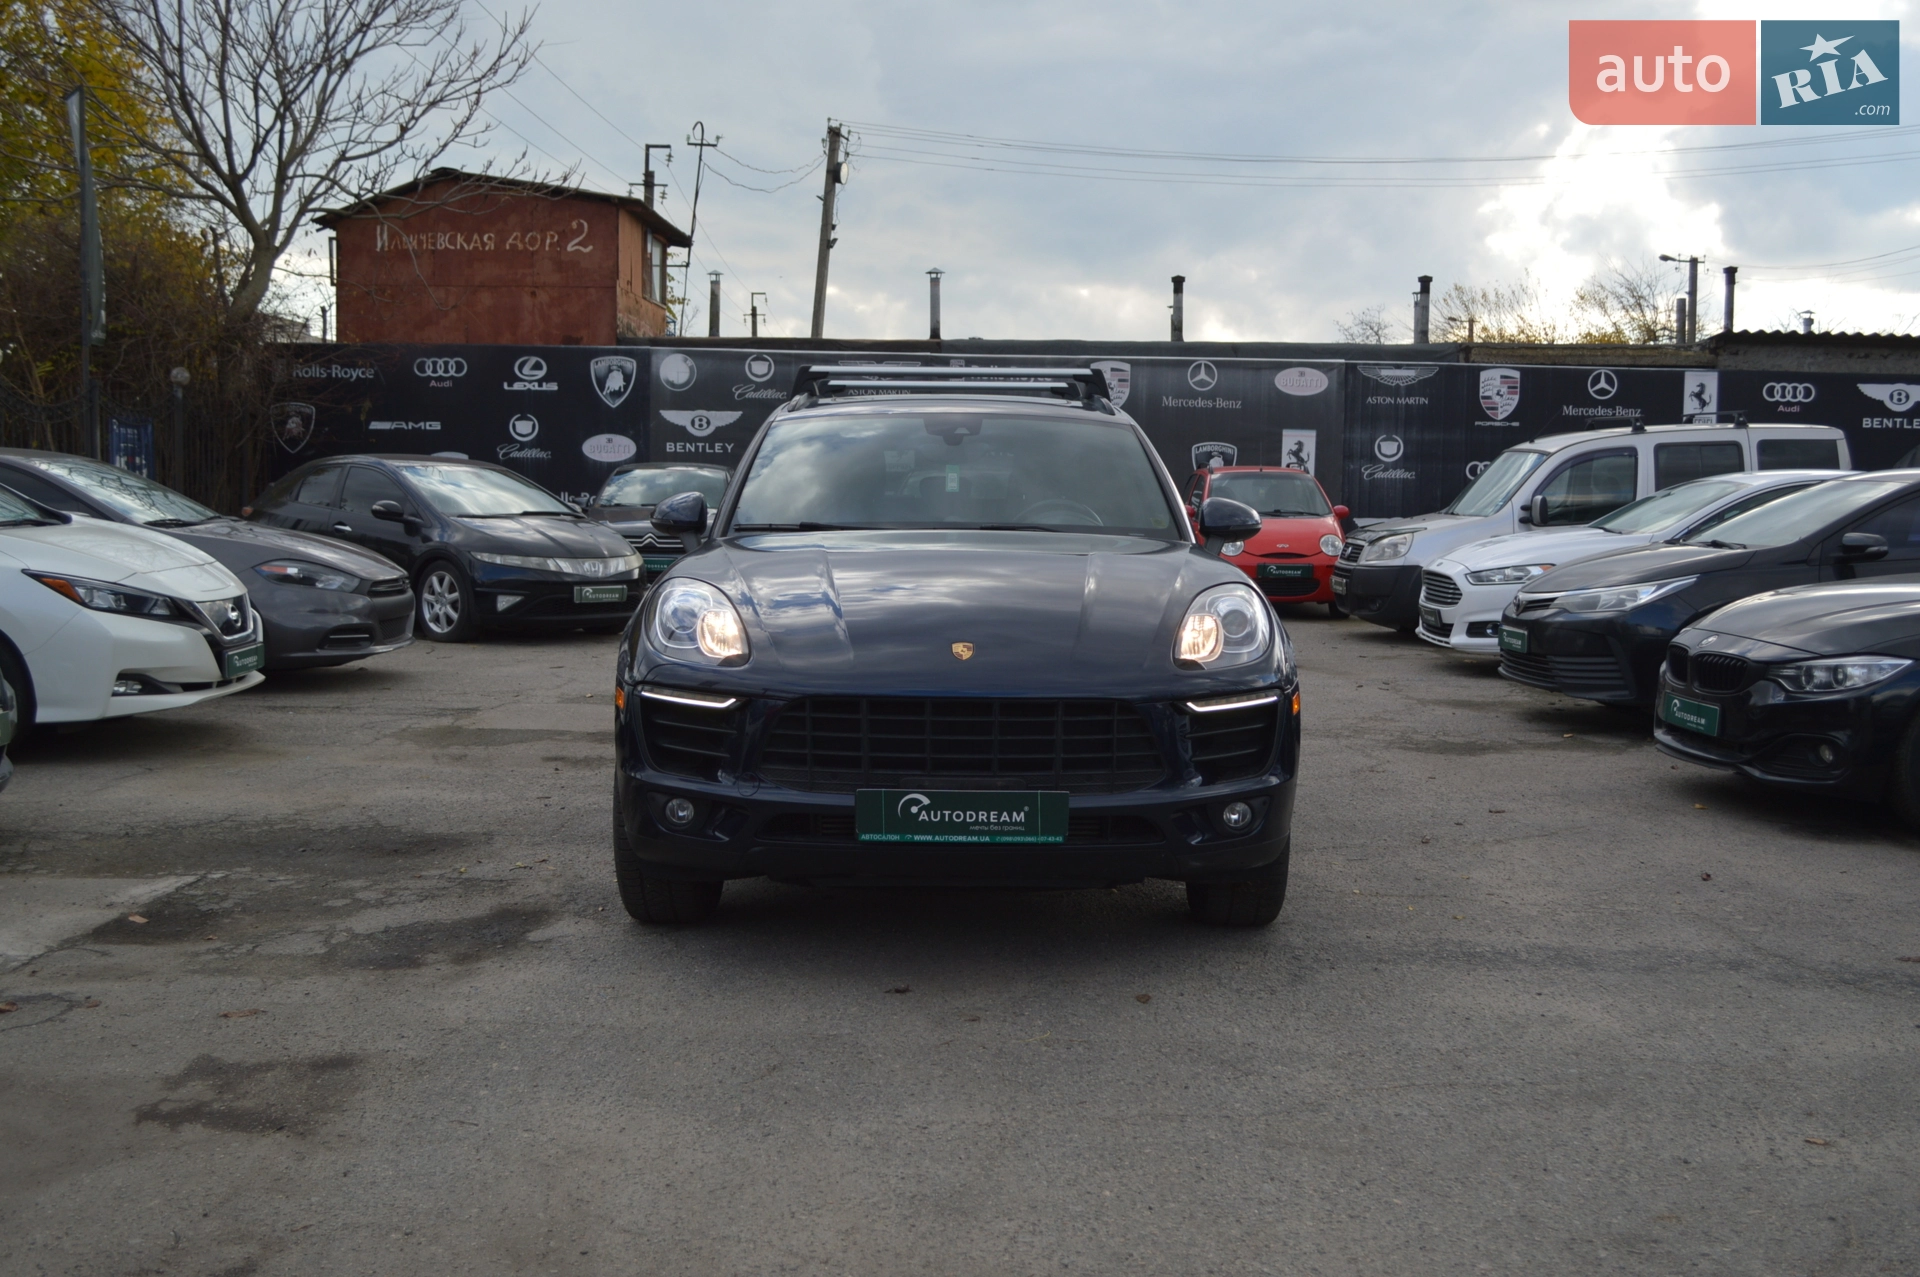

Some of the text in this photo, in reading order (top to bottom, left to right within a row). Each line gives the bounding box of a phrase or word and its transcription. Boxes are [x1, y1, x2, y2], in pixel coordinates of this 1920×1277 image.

[566, 219, 594, 253] 2
[292, 364, 375, 382] Rolls-Royce
[429, 379, 453, 388] Audi
[503, 381, 559, 391] LEXUS
[1281, 377, 1323, 388] BUGATTI
[732, 384, 788, 400] Cadillac
[1162, 396, 1242, 409] Mercedes-Benz
[1366, 396, 1429, 405] ASTON MARTIN
[1562, 405, 1642, 417] Mercedes-Benz
[1777, 405, 1800, 413] Audi
[390, 421, 441, 430] AMG
[496, 443, 552, 459] Cadillac
[589, 444, 631, 454] BUGATTI
[666, 442, 735, 453] BENTLEY
[1195, 444, 1234, 455] LAMBORGHINI
[1361, 463, 1416, 480] Cadillac
[1675, 710, 1706, 725] AUTODREAM
